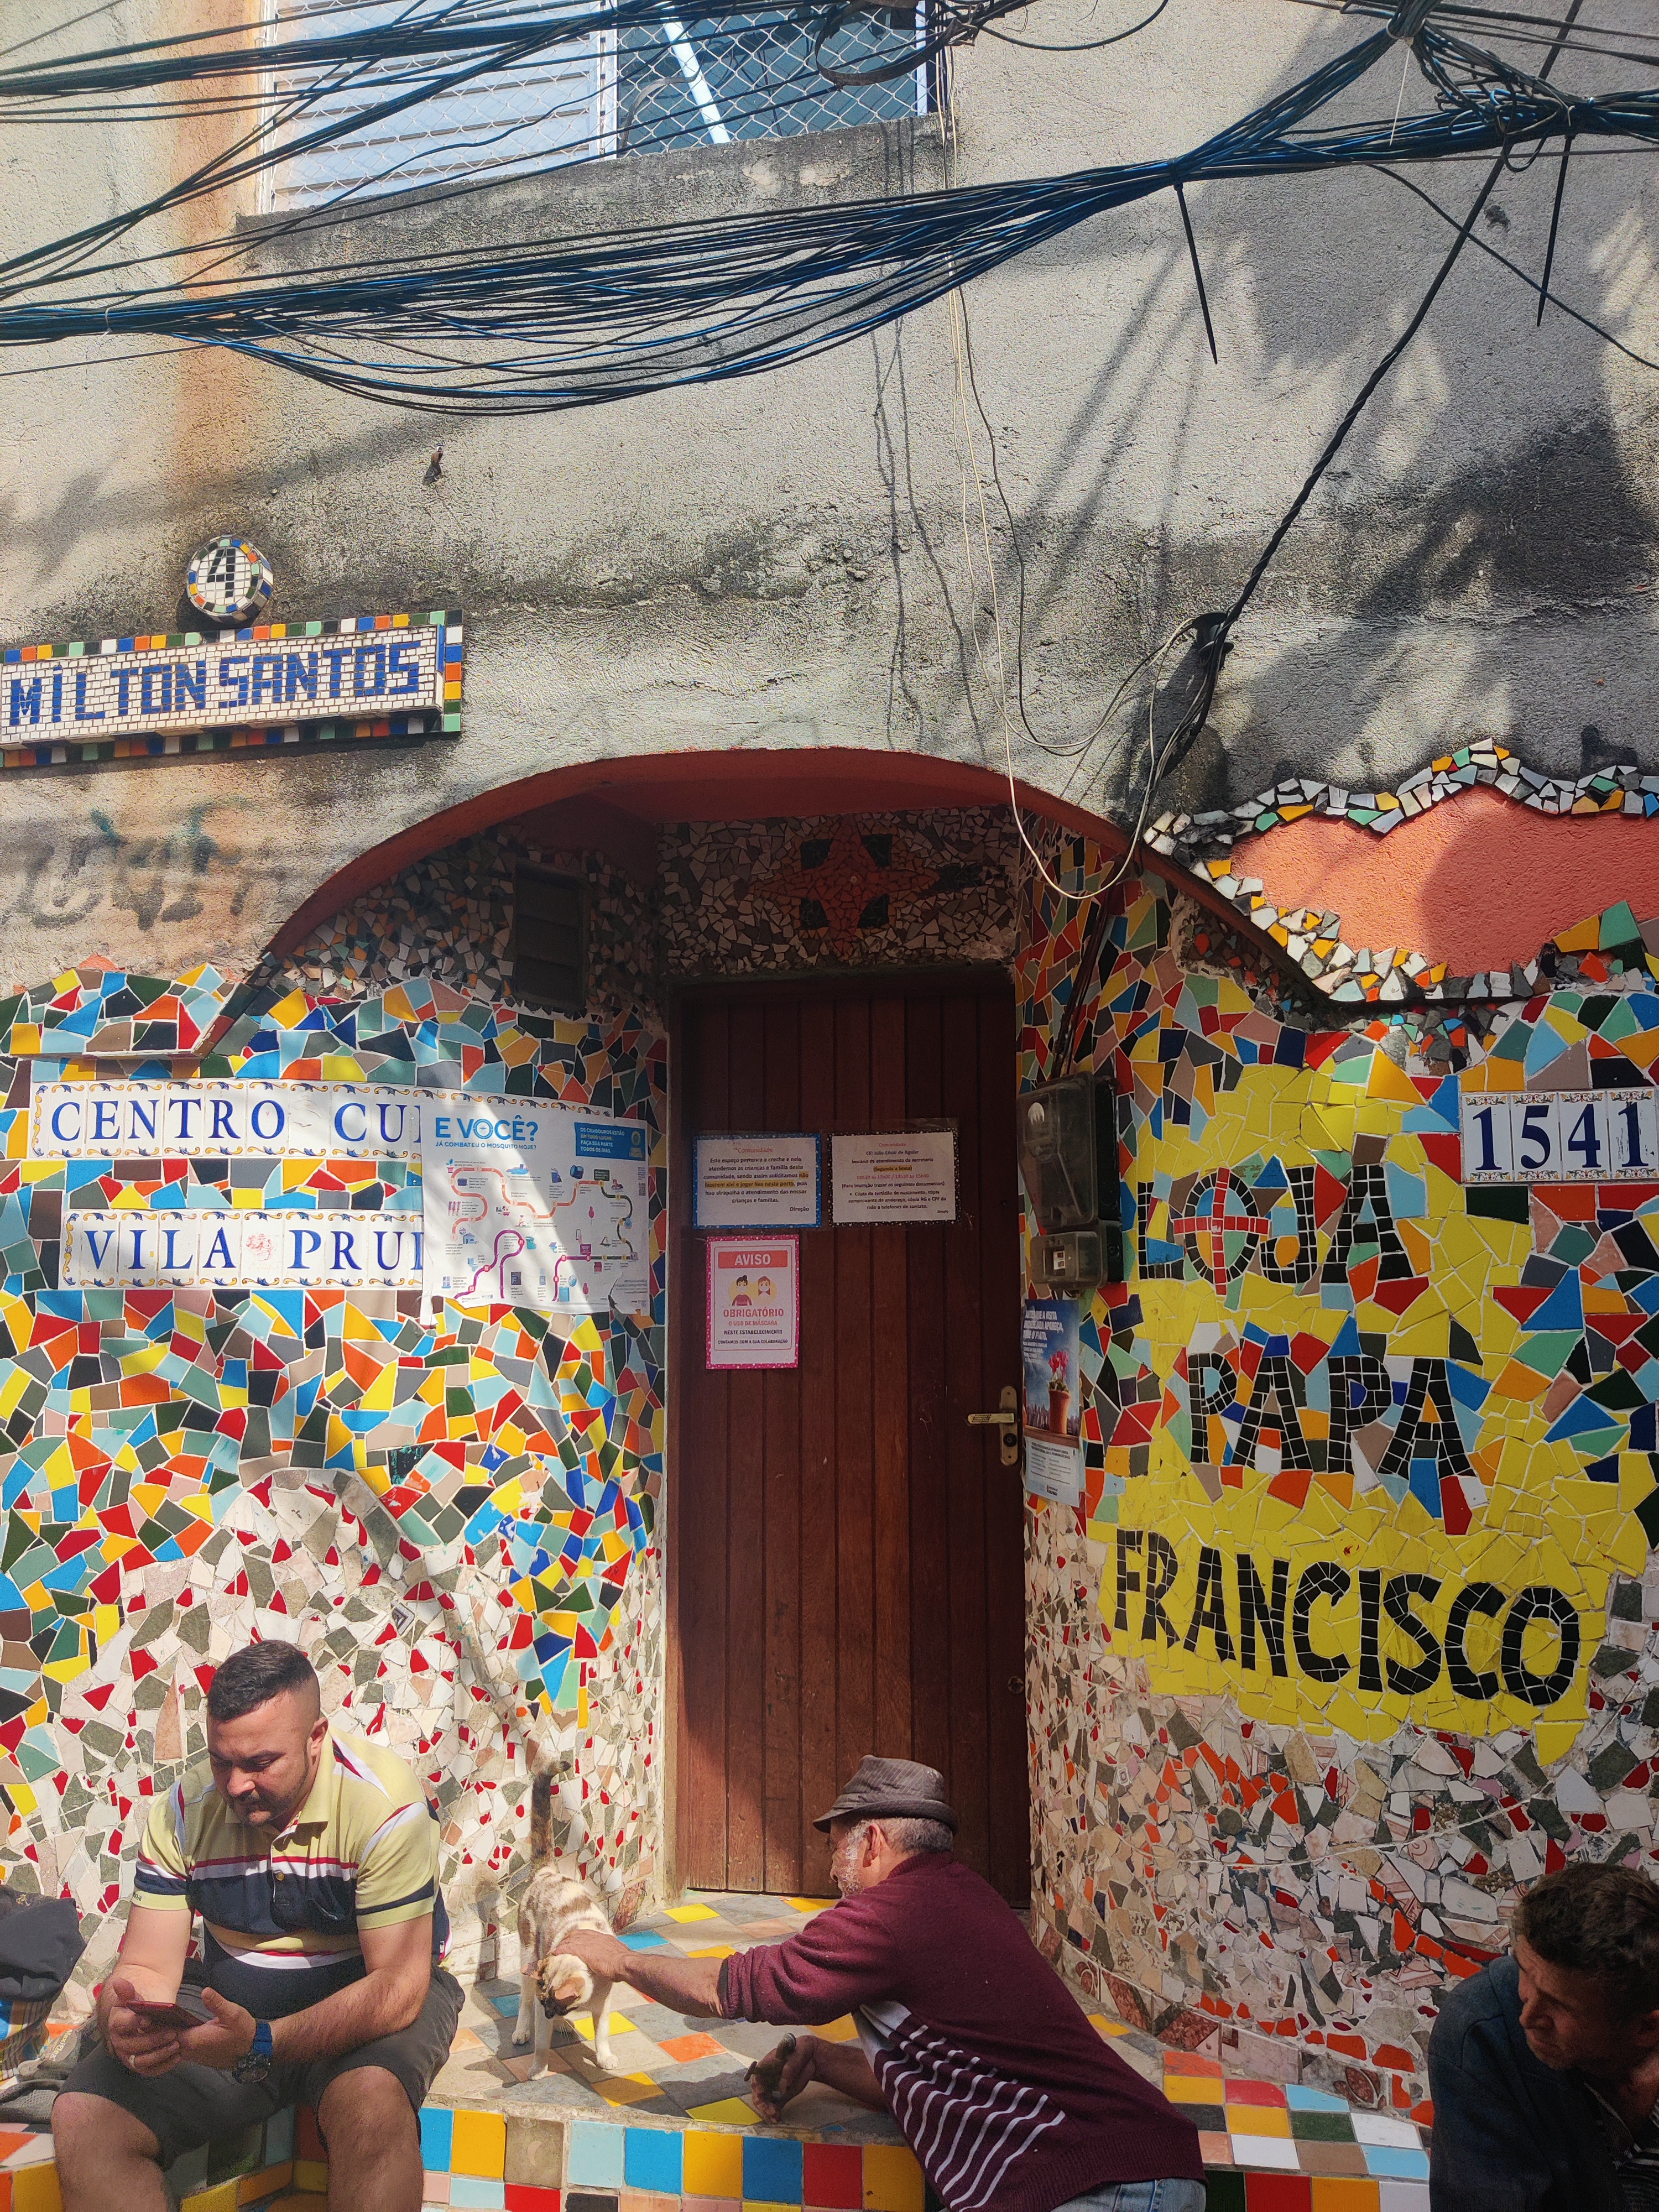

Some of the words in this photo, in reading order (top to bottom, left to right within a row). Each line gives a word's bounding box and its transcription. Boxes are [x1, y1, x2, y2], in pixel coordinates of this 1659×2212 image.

[207, 548, 236, 598] 4
[220, 641, 421, 708] SANTOS
[51, 1097, 285, 1143] CENTRO
[436, 1118, 451, 1138] E
[457, 1114, 539, 1141] VOCÊ?
[1473, 1102, 1649, 1171] 1541
[84, 1226, 237, 1270] VILA
[1138, 1163, 1414, 1286] LOJA
[734, 1253, 771, 1266] AVISO
[723, 1306, 784, 1317] OBRIGATÓRIO
[1187, 1352, 1478, 1478] PAPA
[1114, 1528, 1579, 1706] FRANCISCO
